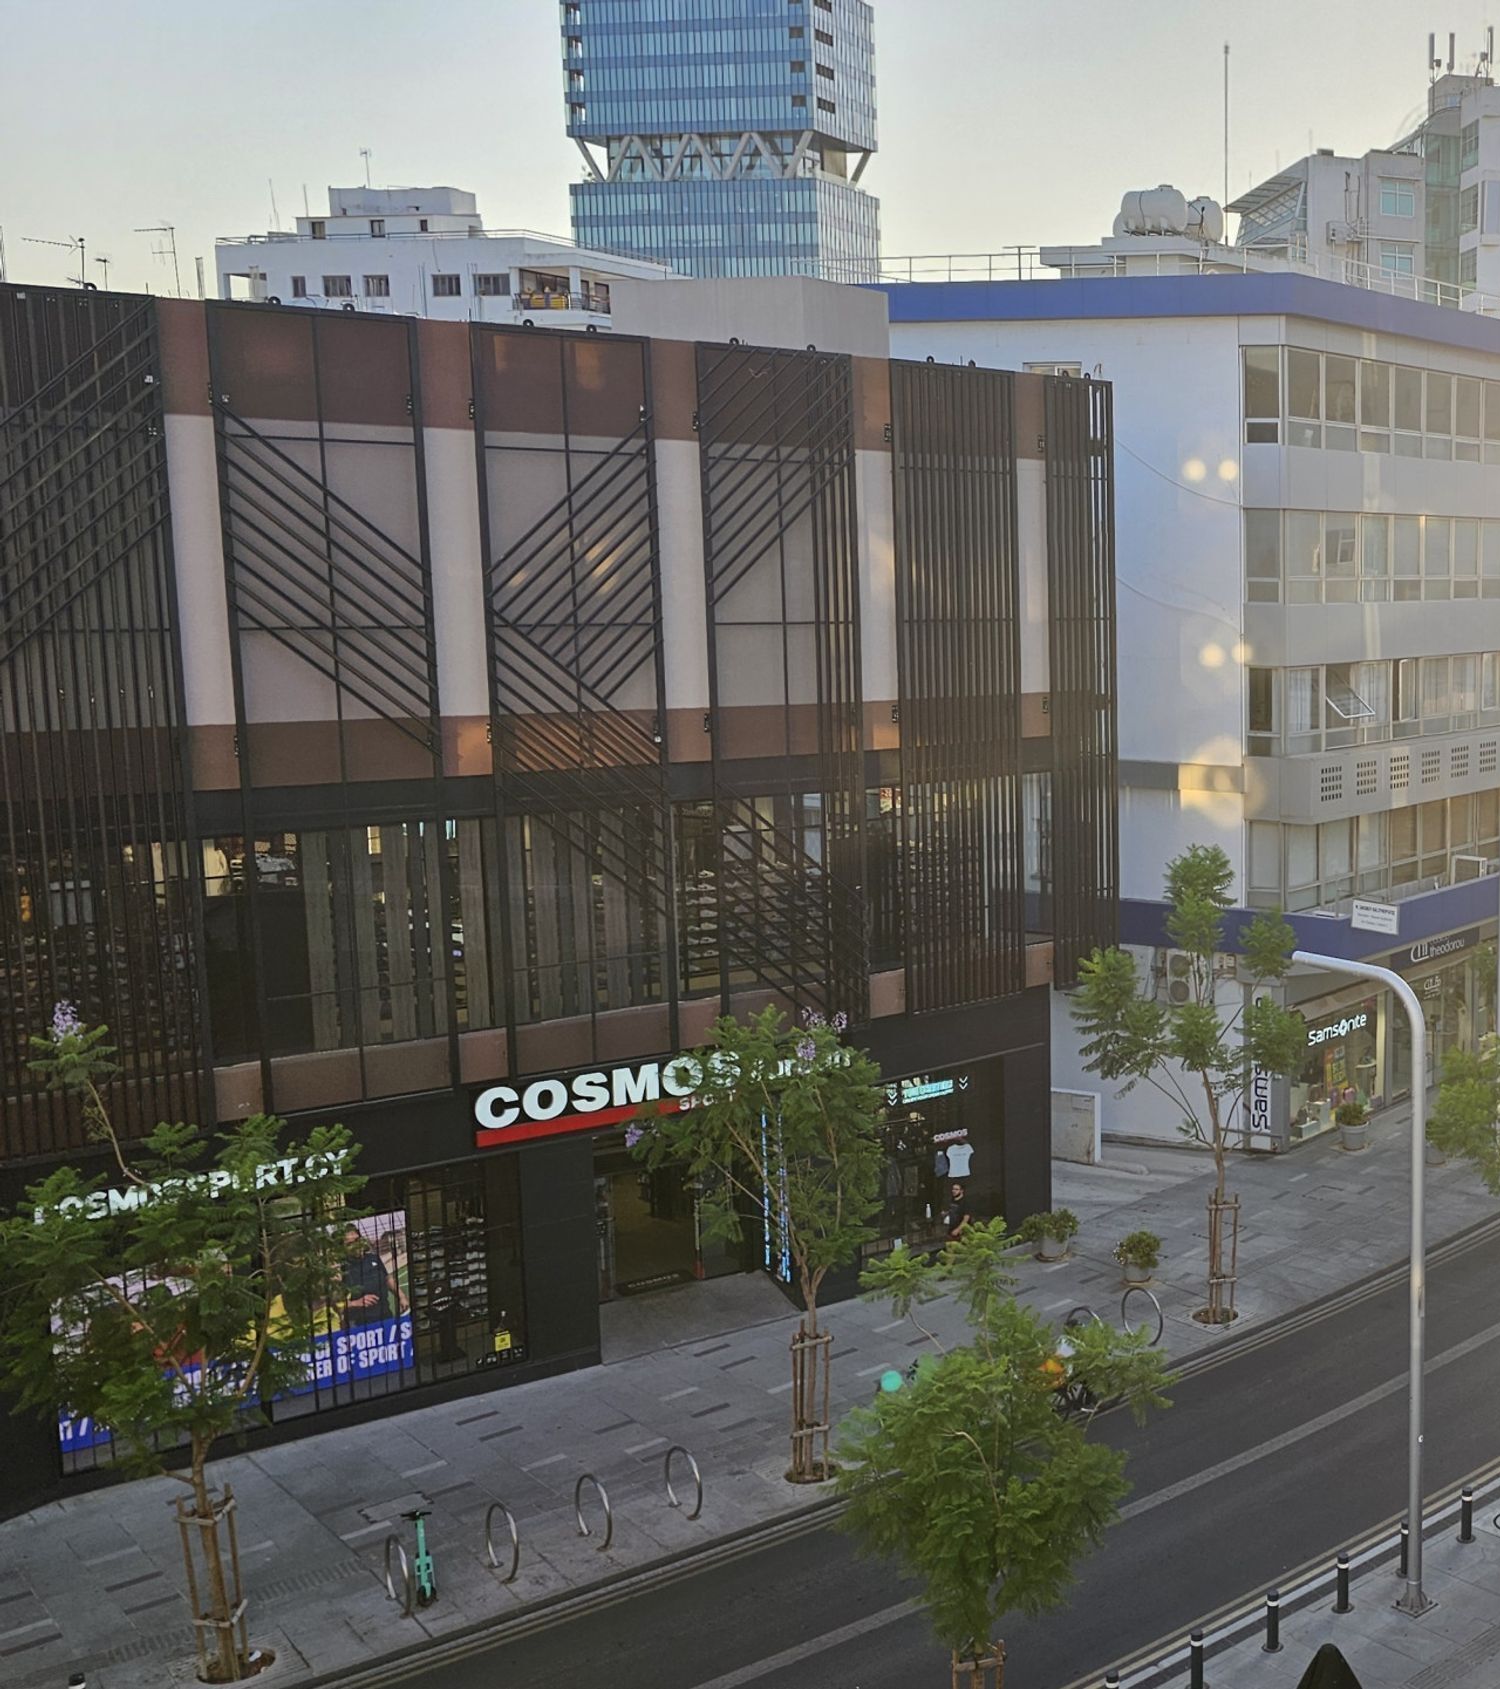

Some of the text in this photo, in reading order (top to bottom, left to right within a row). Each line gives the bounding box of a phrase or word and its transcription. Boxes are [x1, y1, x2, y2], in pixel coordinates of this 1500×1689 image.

[1307, 1013, 1367, 1047] Samsonite
[474, 1050, 742, 1131] COSMOS
[678, 1088, 737, 1112] SPOT
[337, 1327, 384, 1355] SPORT
[358, 1340, 406, 1369] SPORT
